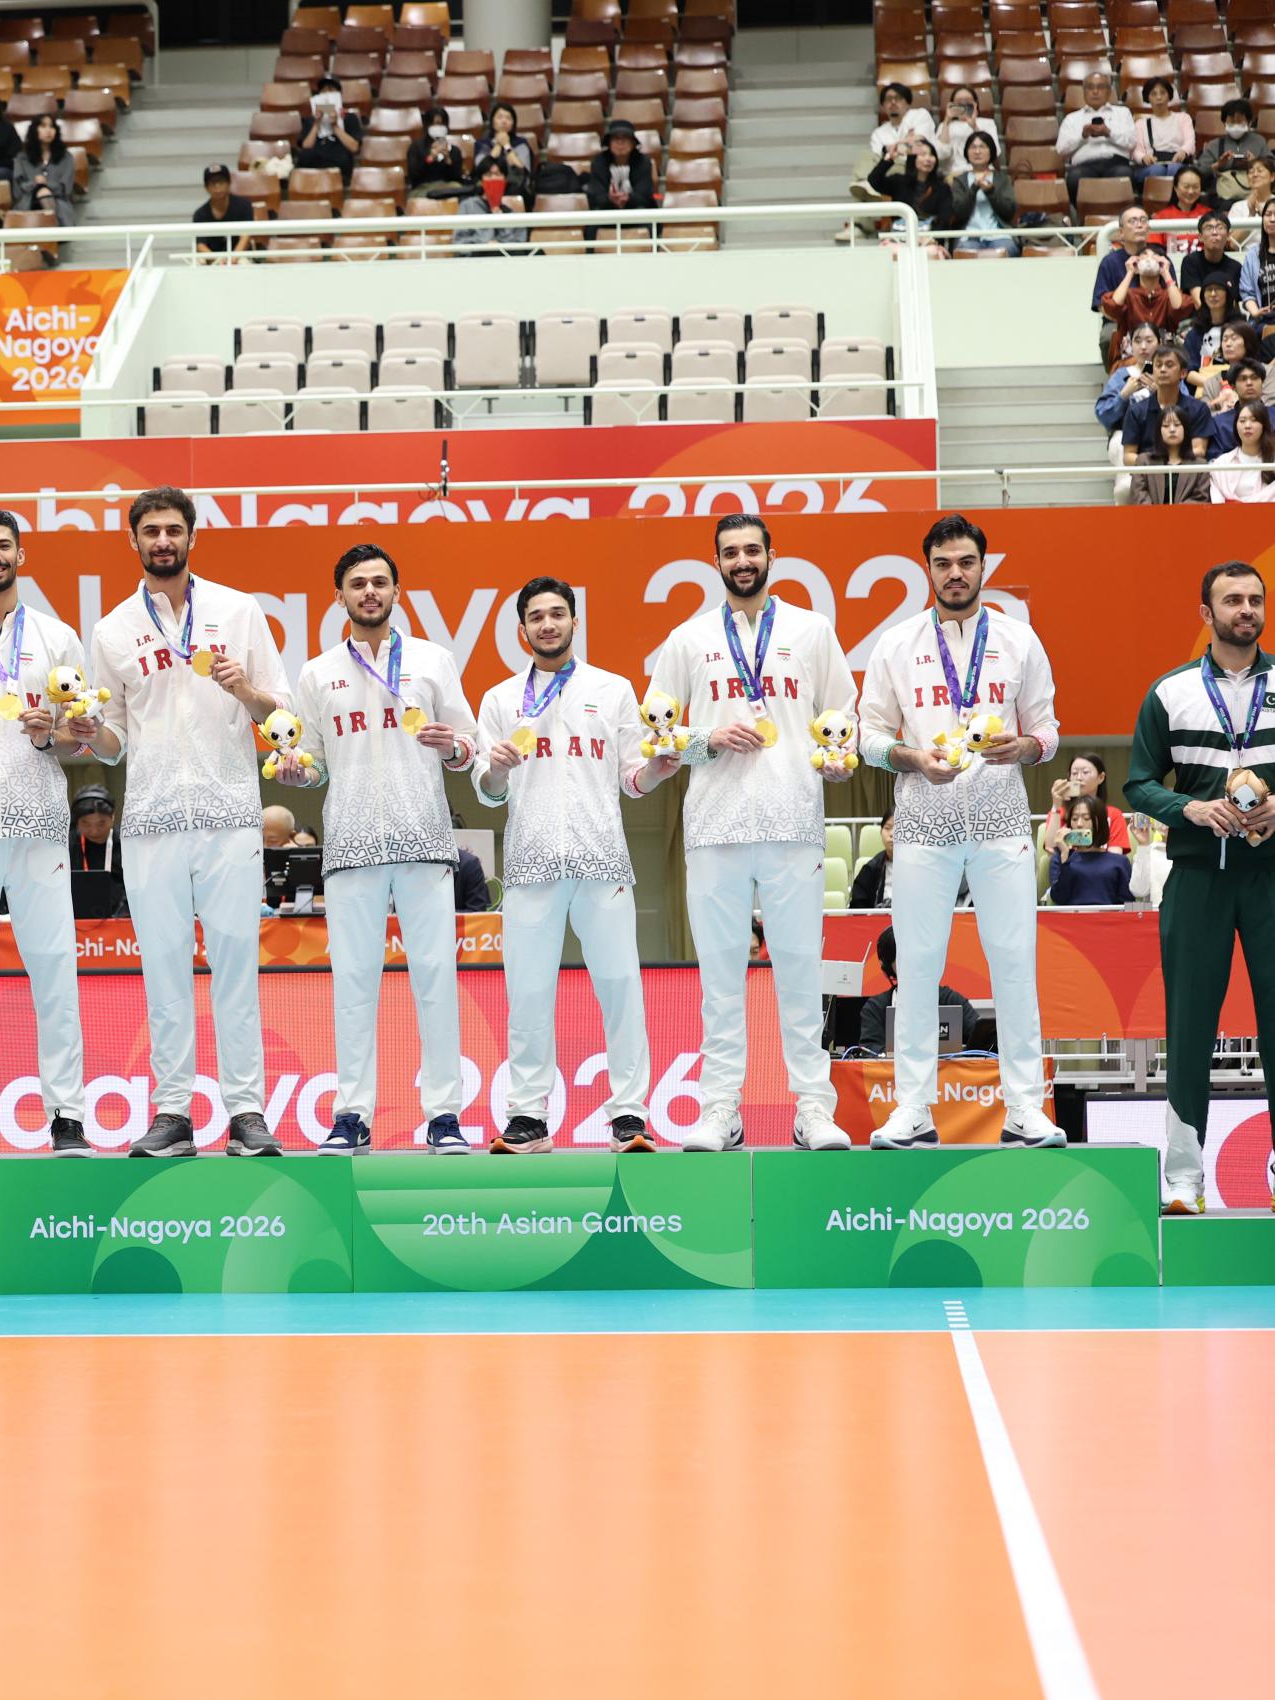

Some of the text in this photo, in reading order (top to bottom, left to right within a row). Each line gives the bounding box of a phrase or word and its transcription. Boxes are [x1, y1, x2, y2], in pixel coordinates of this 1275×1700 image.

[5, 304, 92, 332] Aichi-
[12, 366, 84, 392] 2026
[136, 633, 155, 648] I.R.
[139, 643, 228, 678] IRN
[705, 652, 725, 663] I.R.
[915, 655, 936, 666] I.R.
[331, 679, 350, 691] I.R.
[710, 675, 801, 703] IRAN
[914, 682, 1006, 708] IRN
[333, 706, 400, 737] IRA
[523, 734, 606, 762] RAN
[29, 1215, 287, 1245] Aichi-Nagoya 2026
[422, 1211, 683, 1236] 20th Asian Games
[825, 1206, 1091, 1237] Aichi-Nagoya 2026
